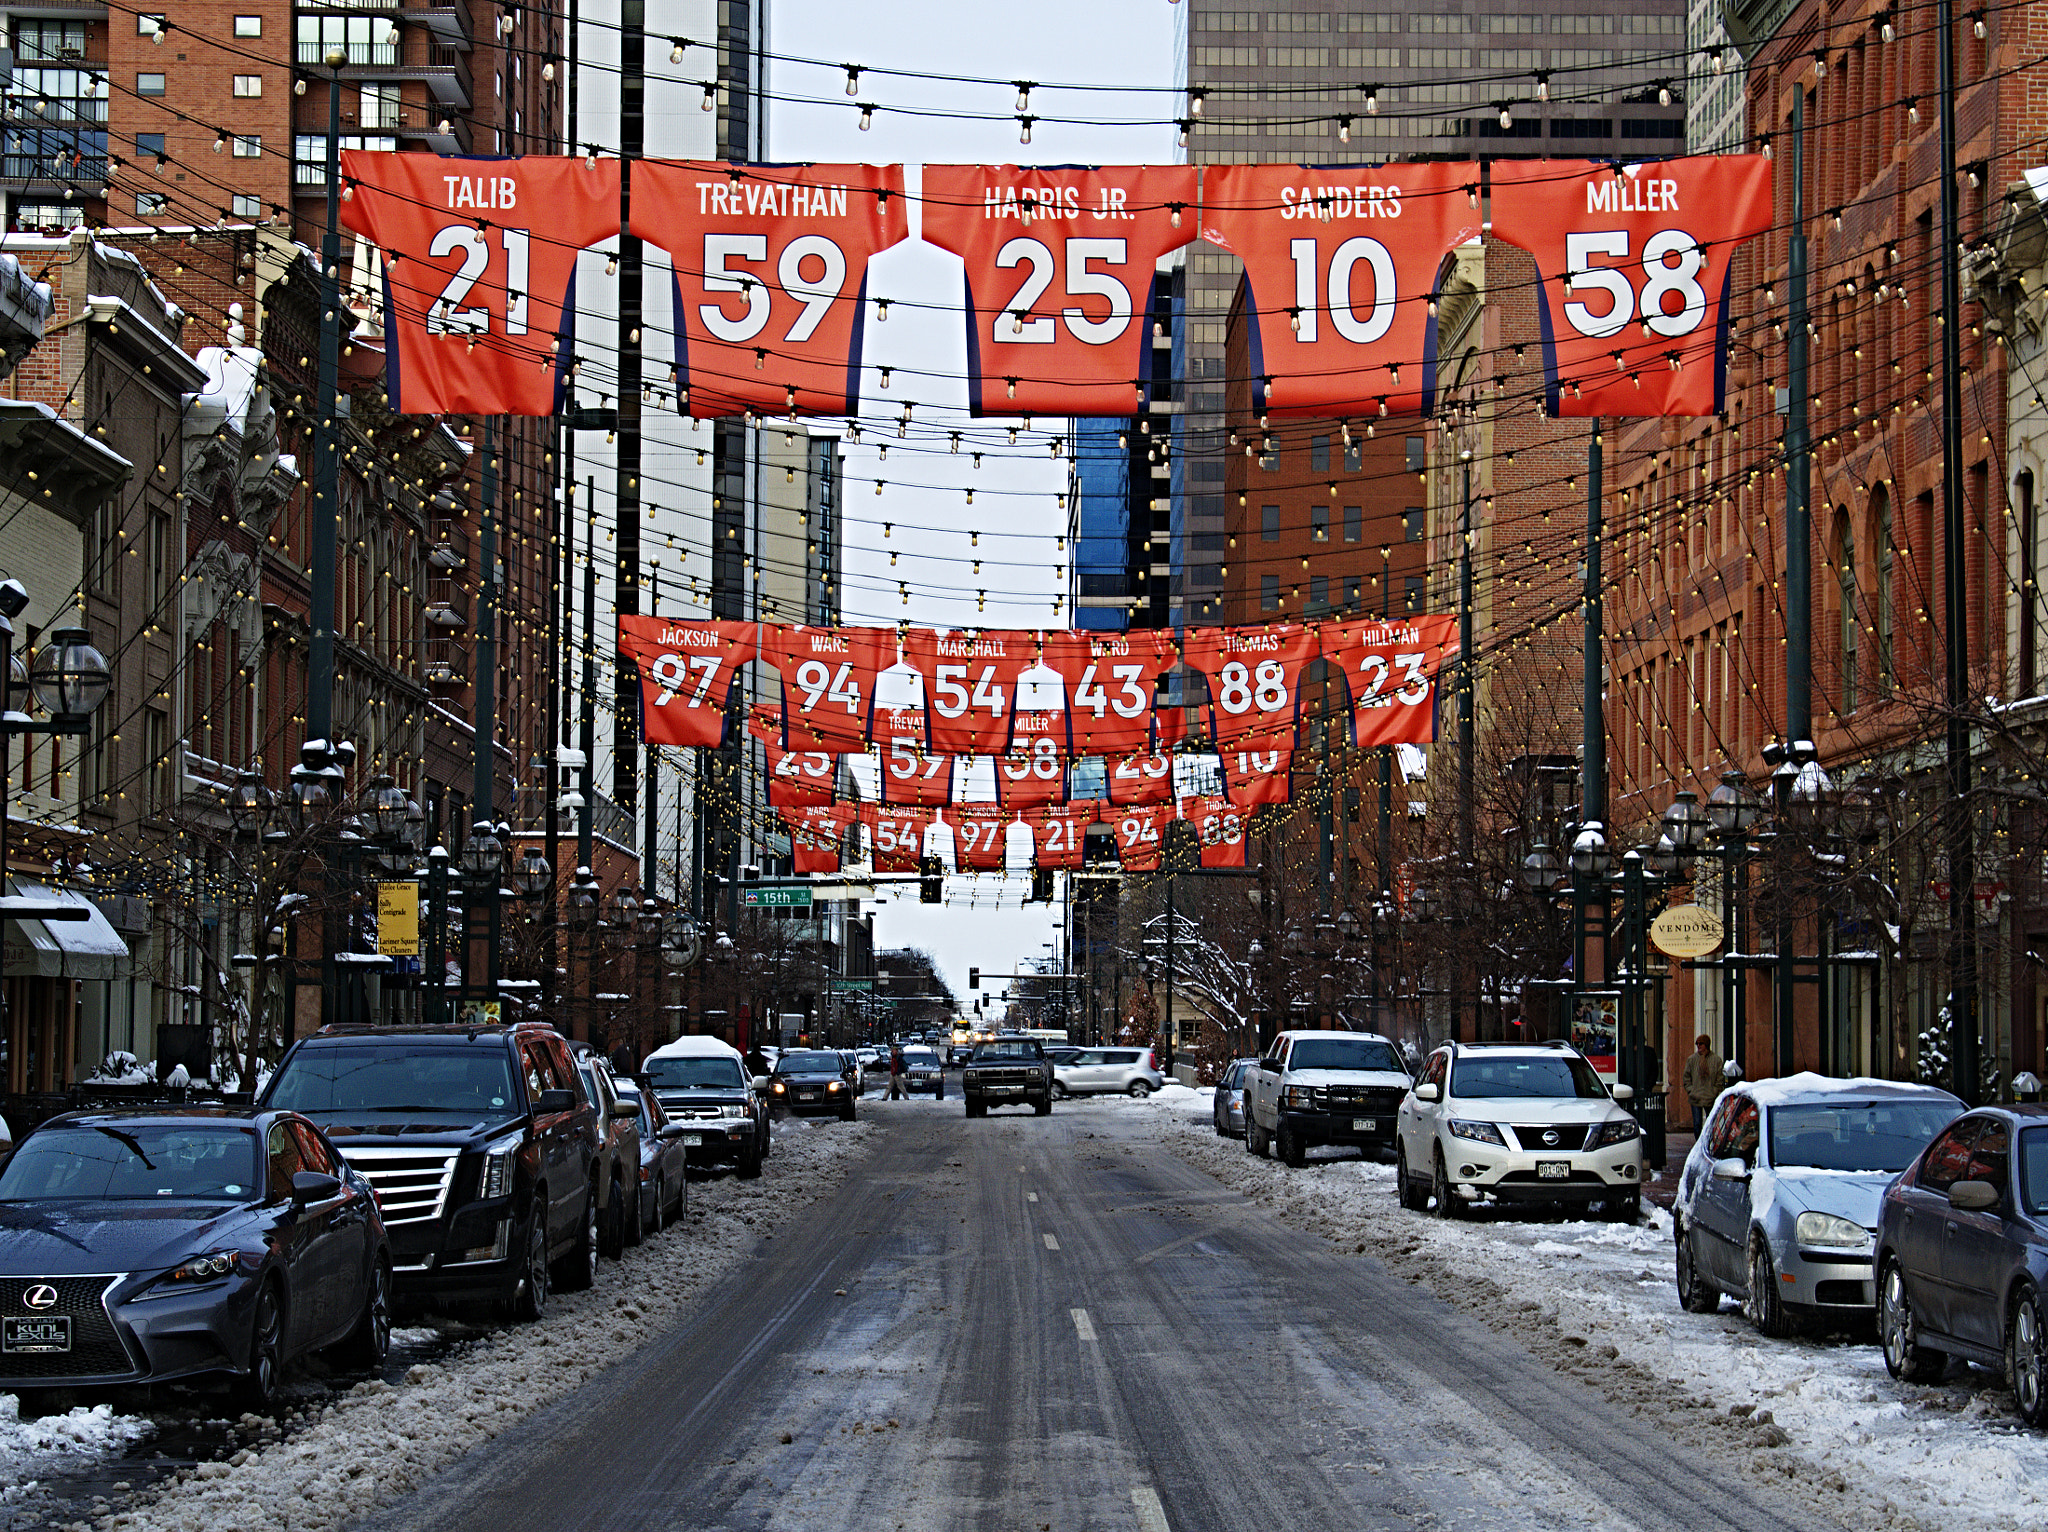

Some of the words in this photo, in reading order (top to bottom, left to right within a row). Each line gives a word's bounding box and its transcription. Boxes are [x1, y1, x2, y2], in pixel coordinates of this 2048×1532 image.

[443, 175, 516, 210] TALIB
[696, 182, 847, 217] TREVATHAN
[985, 186, 1079, 220] HARRIS
[1093, 187, 1135, 221] JR.
[1280, 185, 1402, 219] SANDERS
[1587, 179, 1679, 214] MILLER
[426, 225, 530, 335] 21
[699, 233, 847, 343] 59
[993, 236, 1133, 345] 25
[1290, 236, 1397, 344] 10
[1563, 229, 1707, 338] 58
[657, 628, 719, 648] JACKSON
[811, 635, 849, 653] WARE
[1090, 641, 1130, 657] WRD
[1224, 634, 1278, 653] THOMAS
[1362, 627, 1419, 647] HILLMAN
[652, 653, 724, 709] 97
[796, 660, 861, 714] 94
[933, 664, 1006, 719] 54
[1074, 664, 1147, 719] 43
[1220, 659, 1288, 714] 88
[1359, 652, 1429, 709] 23
[888, 716, 925, 730] TREVAT
[1003, 737, 1057, 779] 58
[878, 807, 919, 817] MARSHALL
[796, 820, 838, 852] 43
[876, 821, 918, 852] 54
[960, 821, 999, 852] 97
[1045, 820, 1075, 851] 21
[1121, 818, 1159, 848] 94
[1203, 814, 1242, 845] 88
[379, 899, 391, 907] Sally
[379, 908, 406, 916] Centigrade
[764, 892, 790, 903] 15th
[379, 946, 390, 954] Dry
[390, 945, 412, 954] Cleaners
[401, 937, 418, 946] Square
[7, 1332, 66, 1340] LEXUS
[17, 1324, 56, 1332] KUNI
